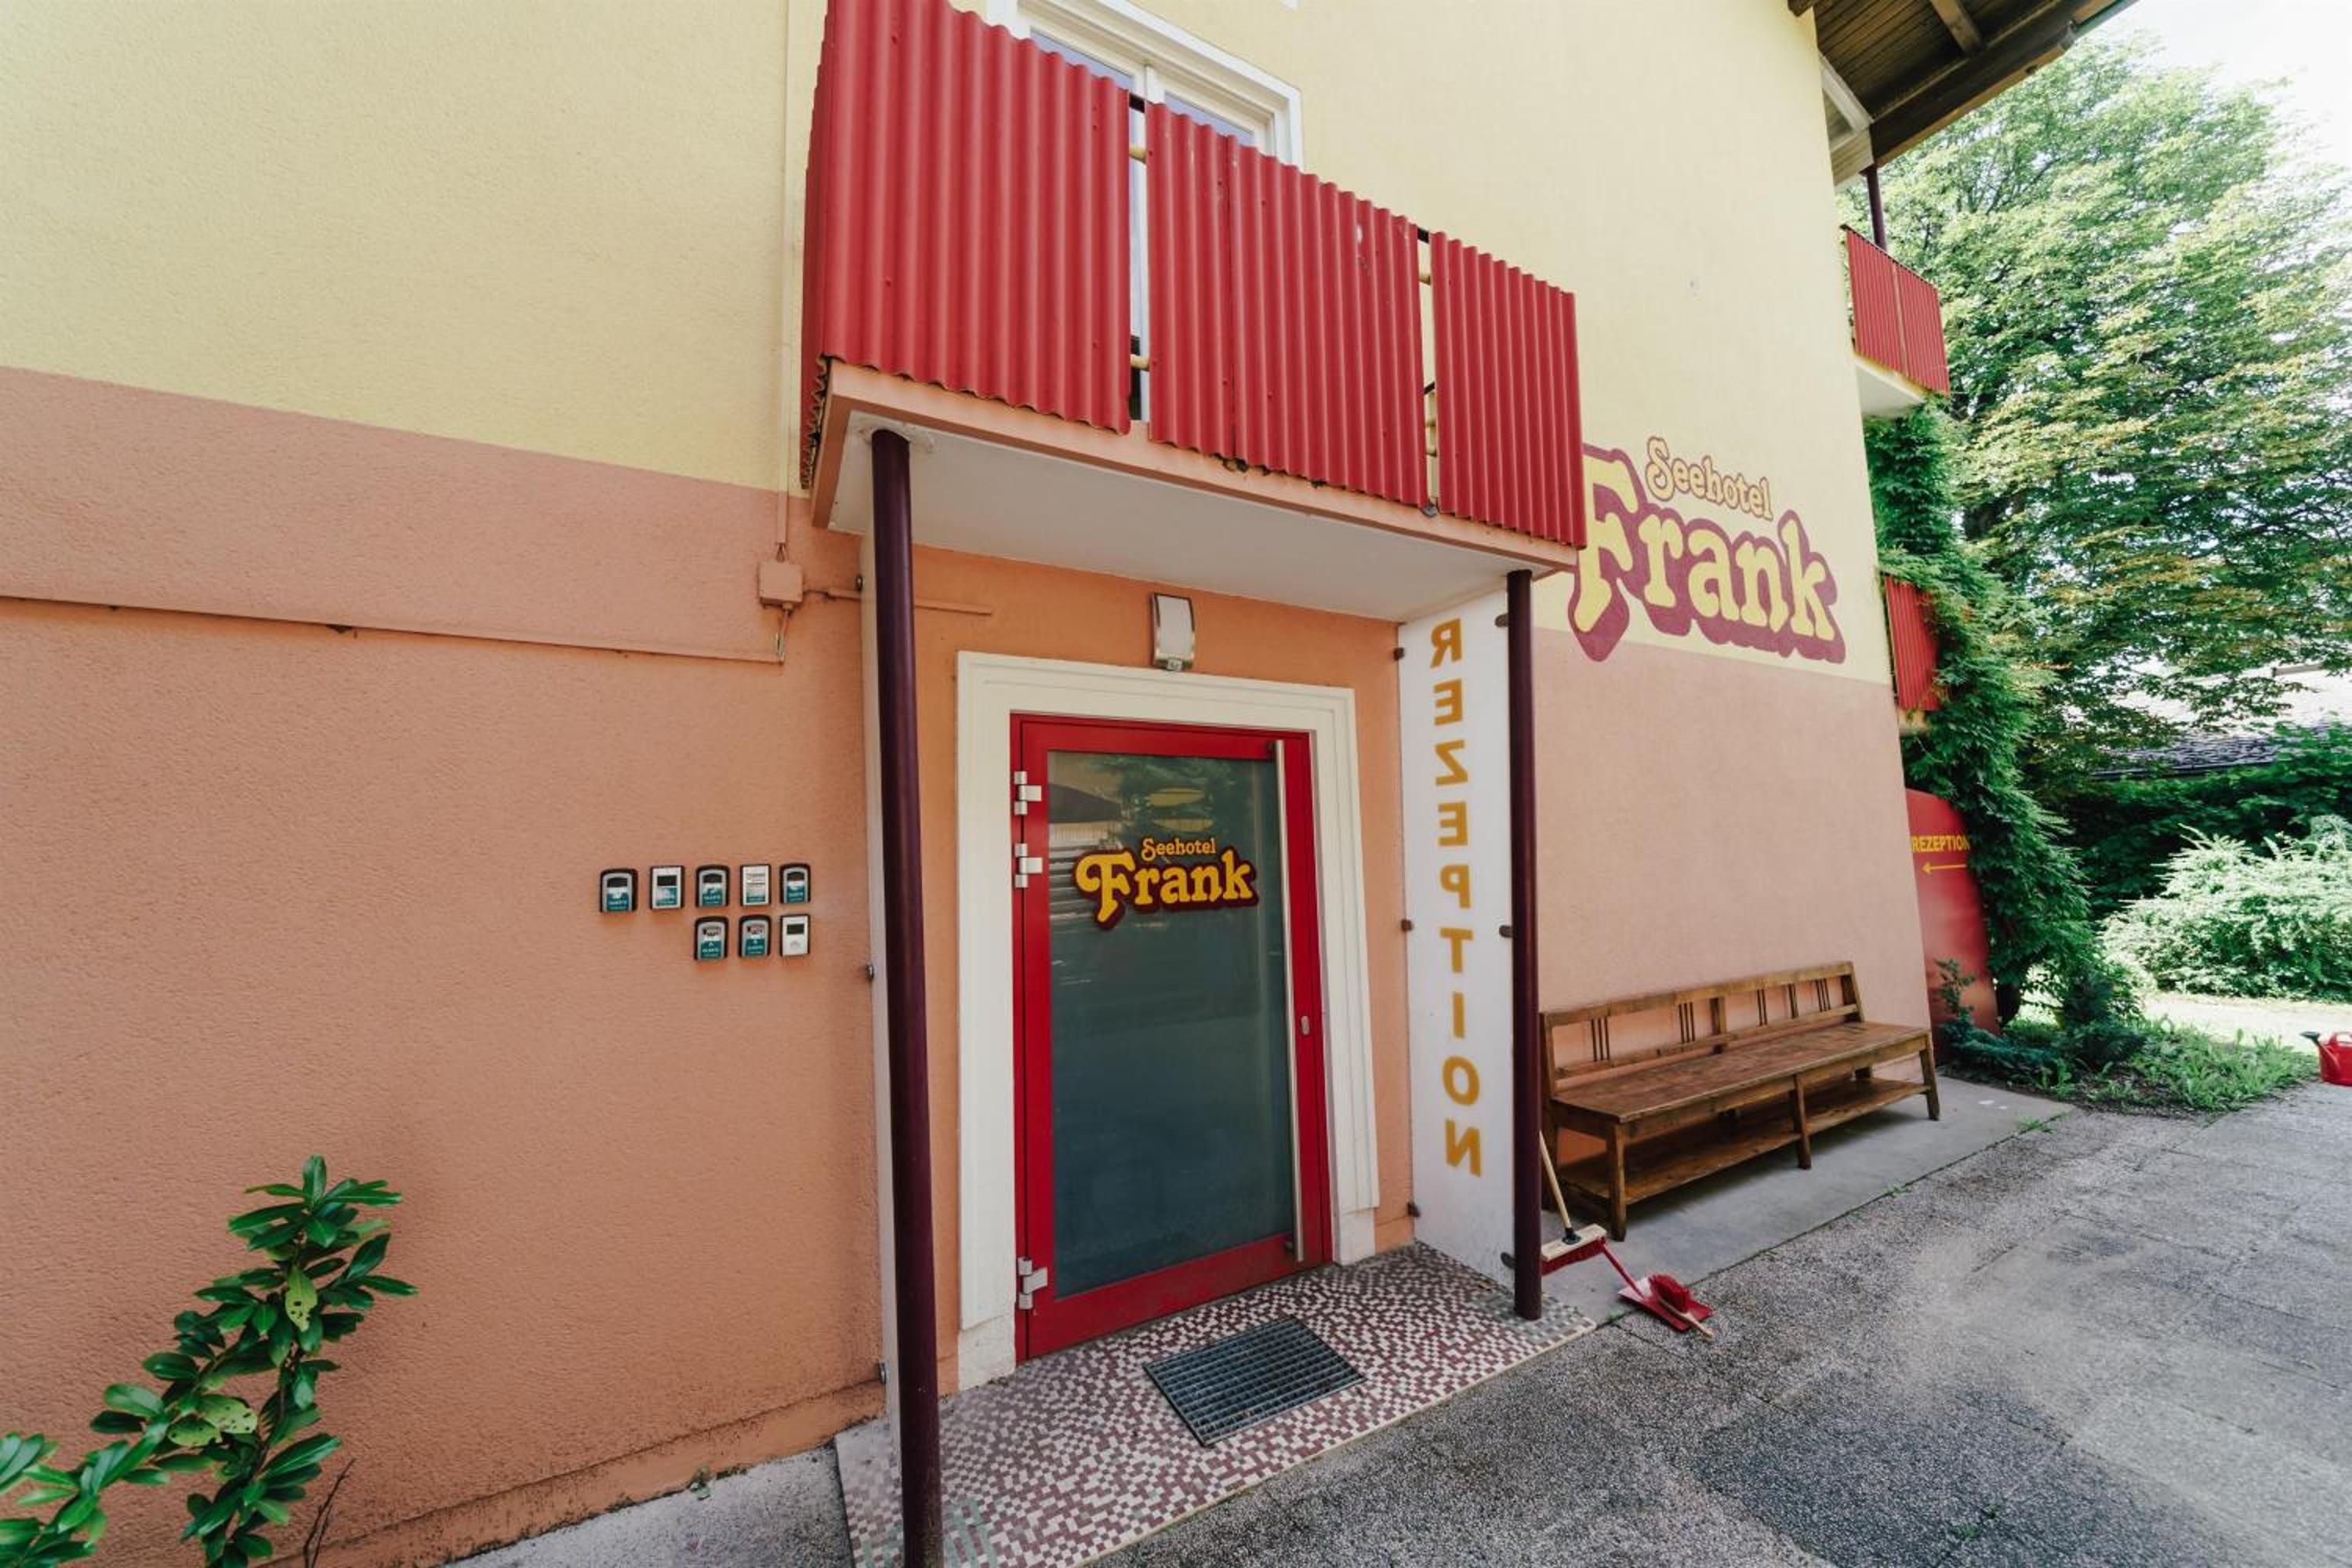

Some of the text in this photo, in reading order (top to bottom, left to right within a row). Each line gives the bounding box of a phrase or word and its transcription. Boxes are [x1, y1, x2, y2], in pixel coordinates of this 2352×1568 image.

[1646, 437, 1773, 521] Seehotel
[1570, 446, 1845, 660] Frank
[1073, 848, 1257, 927] Frank
[1141, 837, 1217, 862] Seehotel
